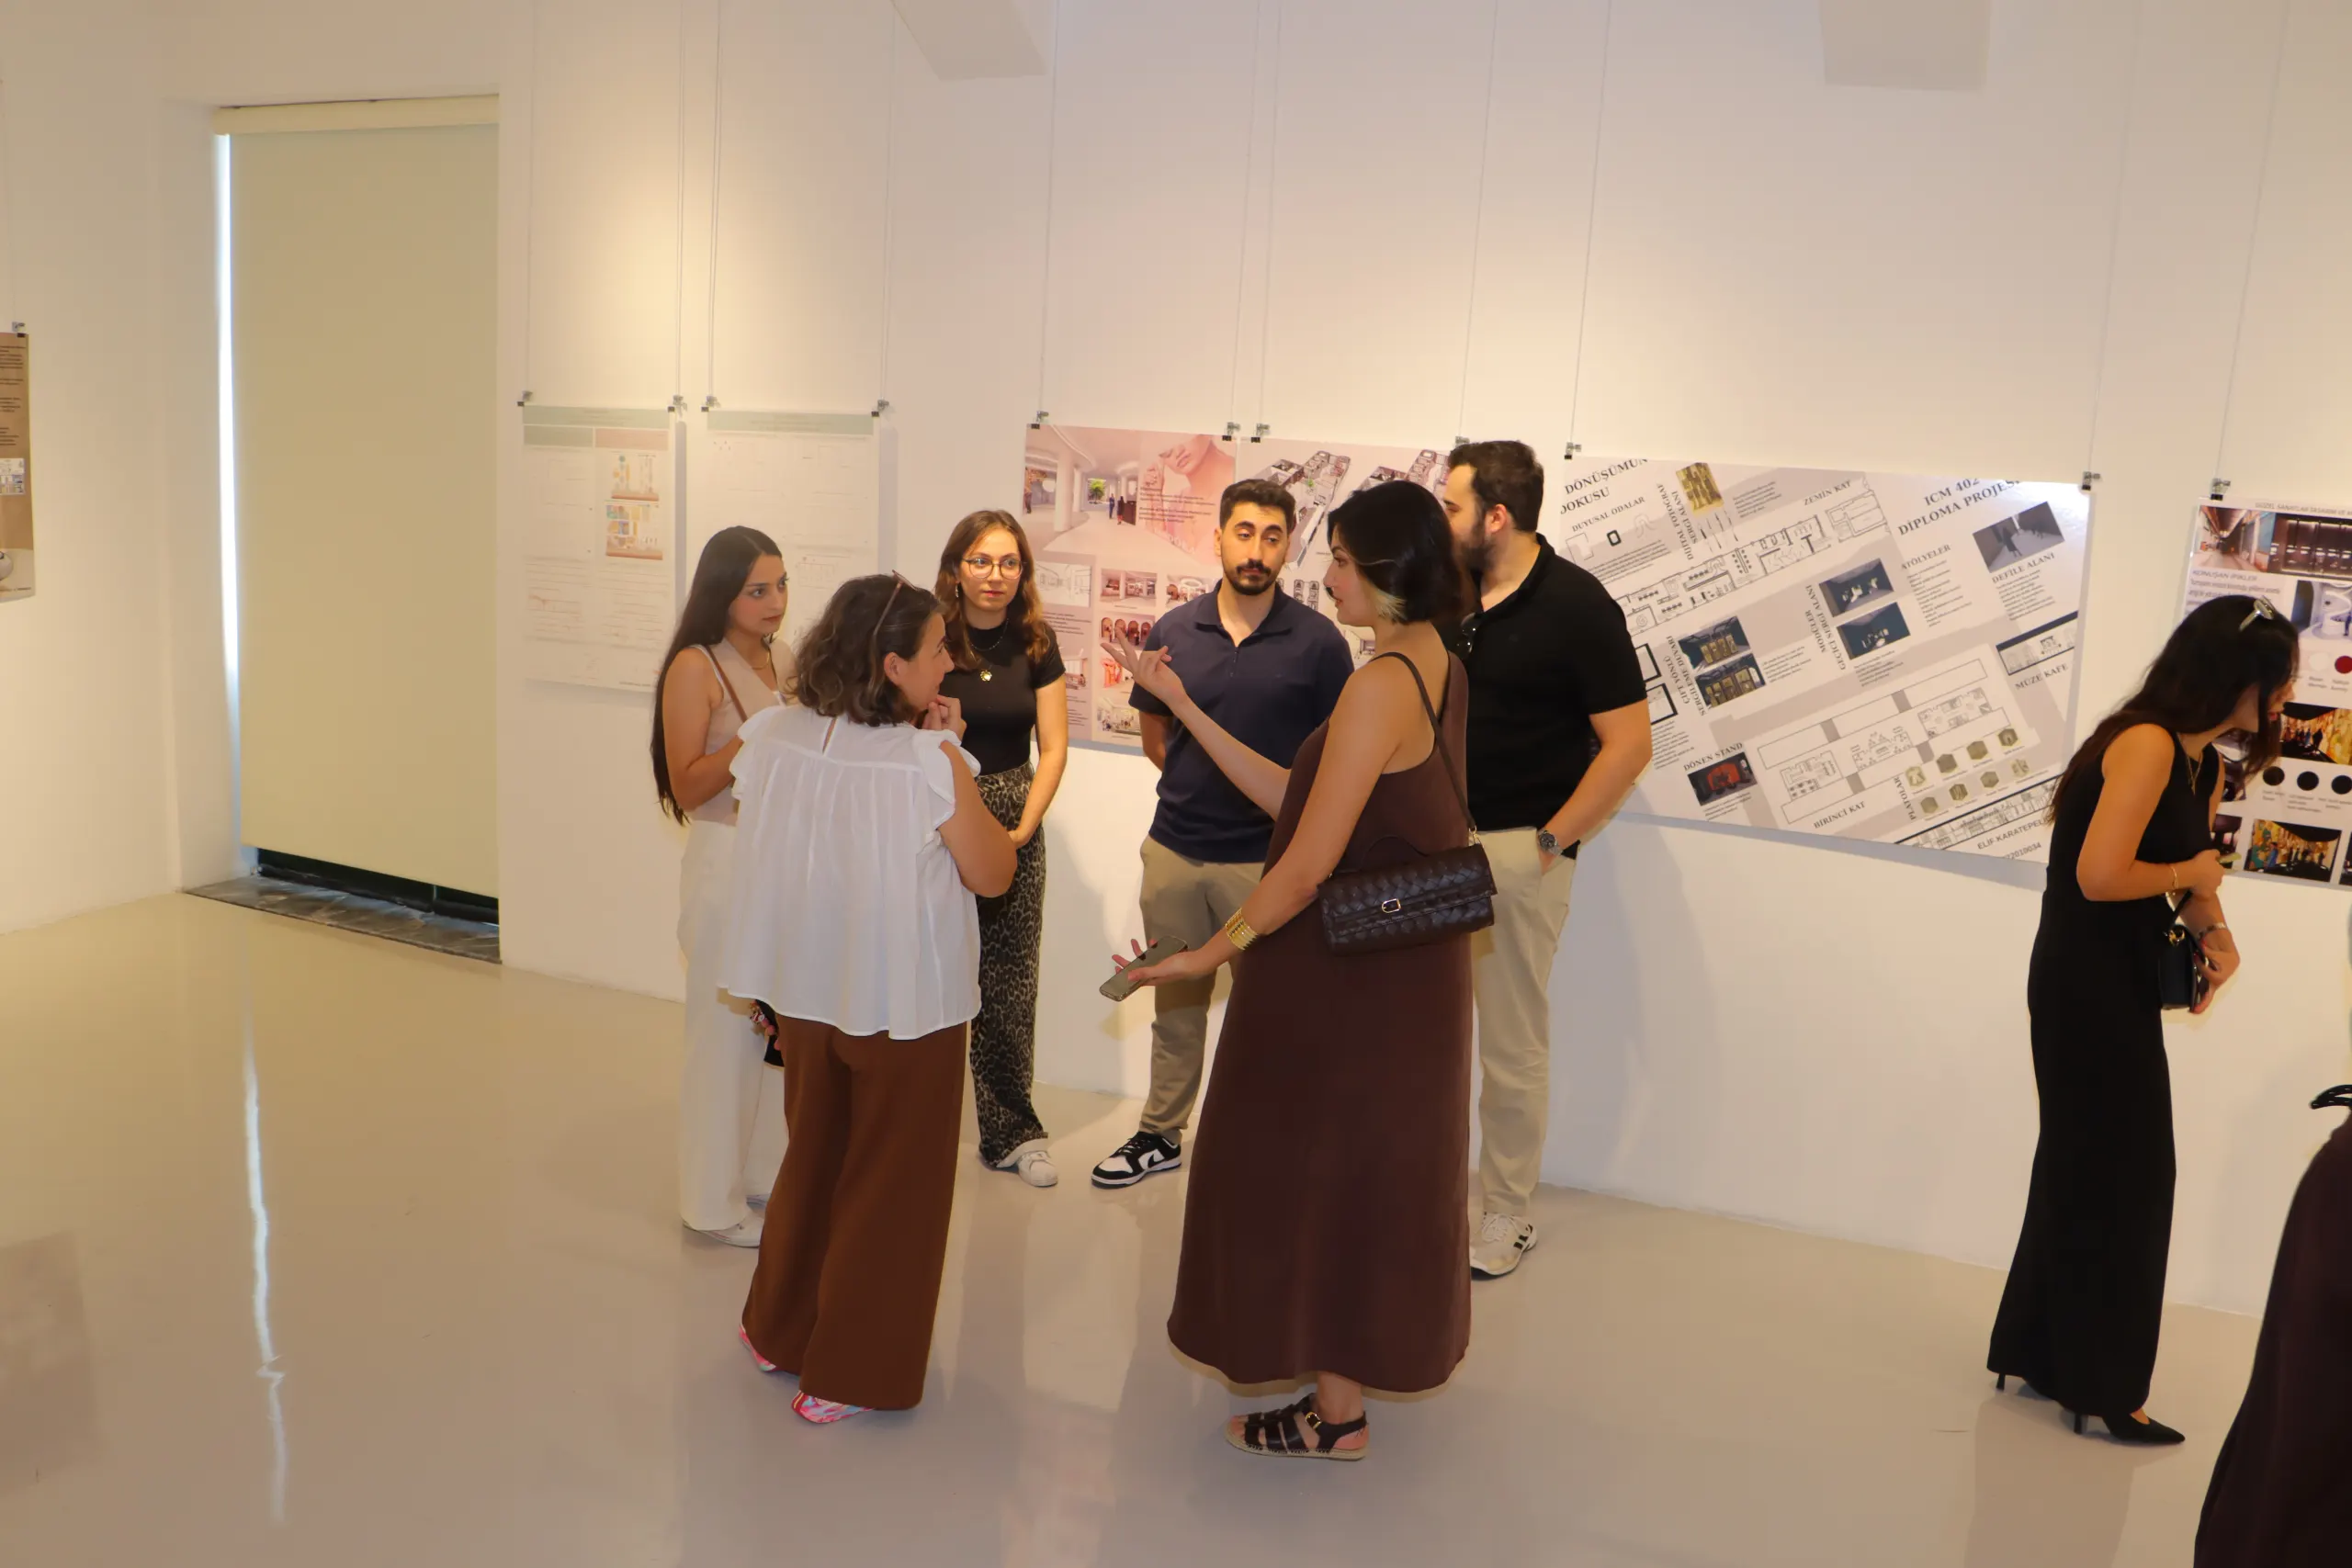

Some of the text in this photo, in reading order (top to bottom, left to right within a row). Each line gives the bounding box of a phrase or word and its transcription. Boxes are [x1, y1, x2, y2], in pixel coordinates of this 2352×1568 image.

[1804, 479, 1852, 506] ZEMİN KAT
[1923, 487, 1952, 506] ICM
[1571, 496, 1645, 532] DUYUSAL ODALAR
[1897, 502, 1962, 536] DİPLOMA
[1900, 544, 1951, 571] ATÖLYELER
[1992, 552, 2056, 584] DEFİLE ALANI
[1666, 635, 1687, 666] DUVARI
[2043, 662, 2069, 680] KAFE
[1683, 742, 1744, 772] DÖNEN STAND
[1893, 776, 1917, 821] PLATOLAR
[1813, 800, 1866, 829] BİRİNCİ KAT
[1977, 833, 1996, 850] ELİF
